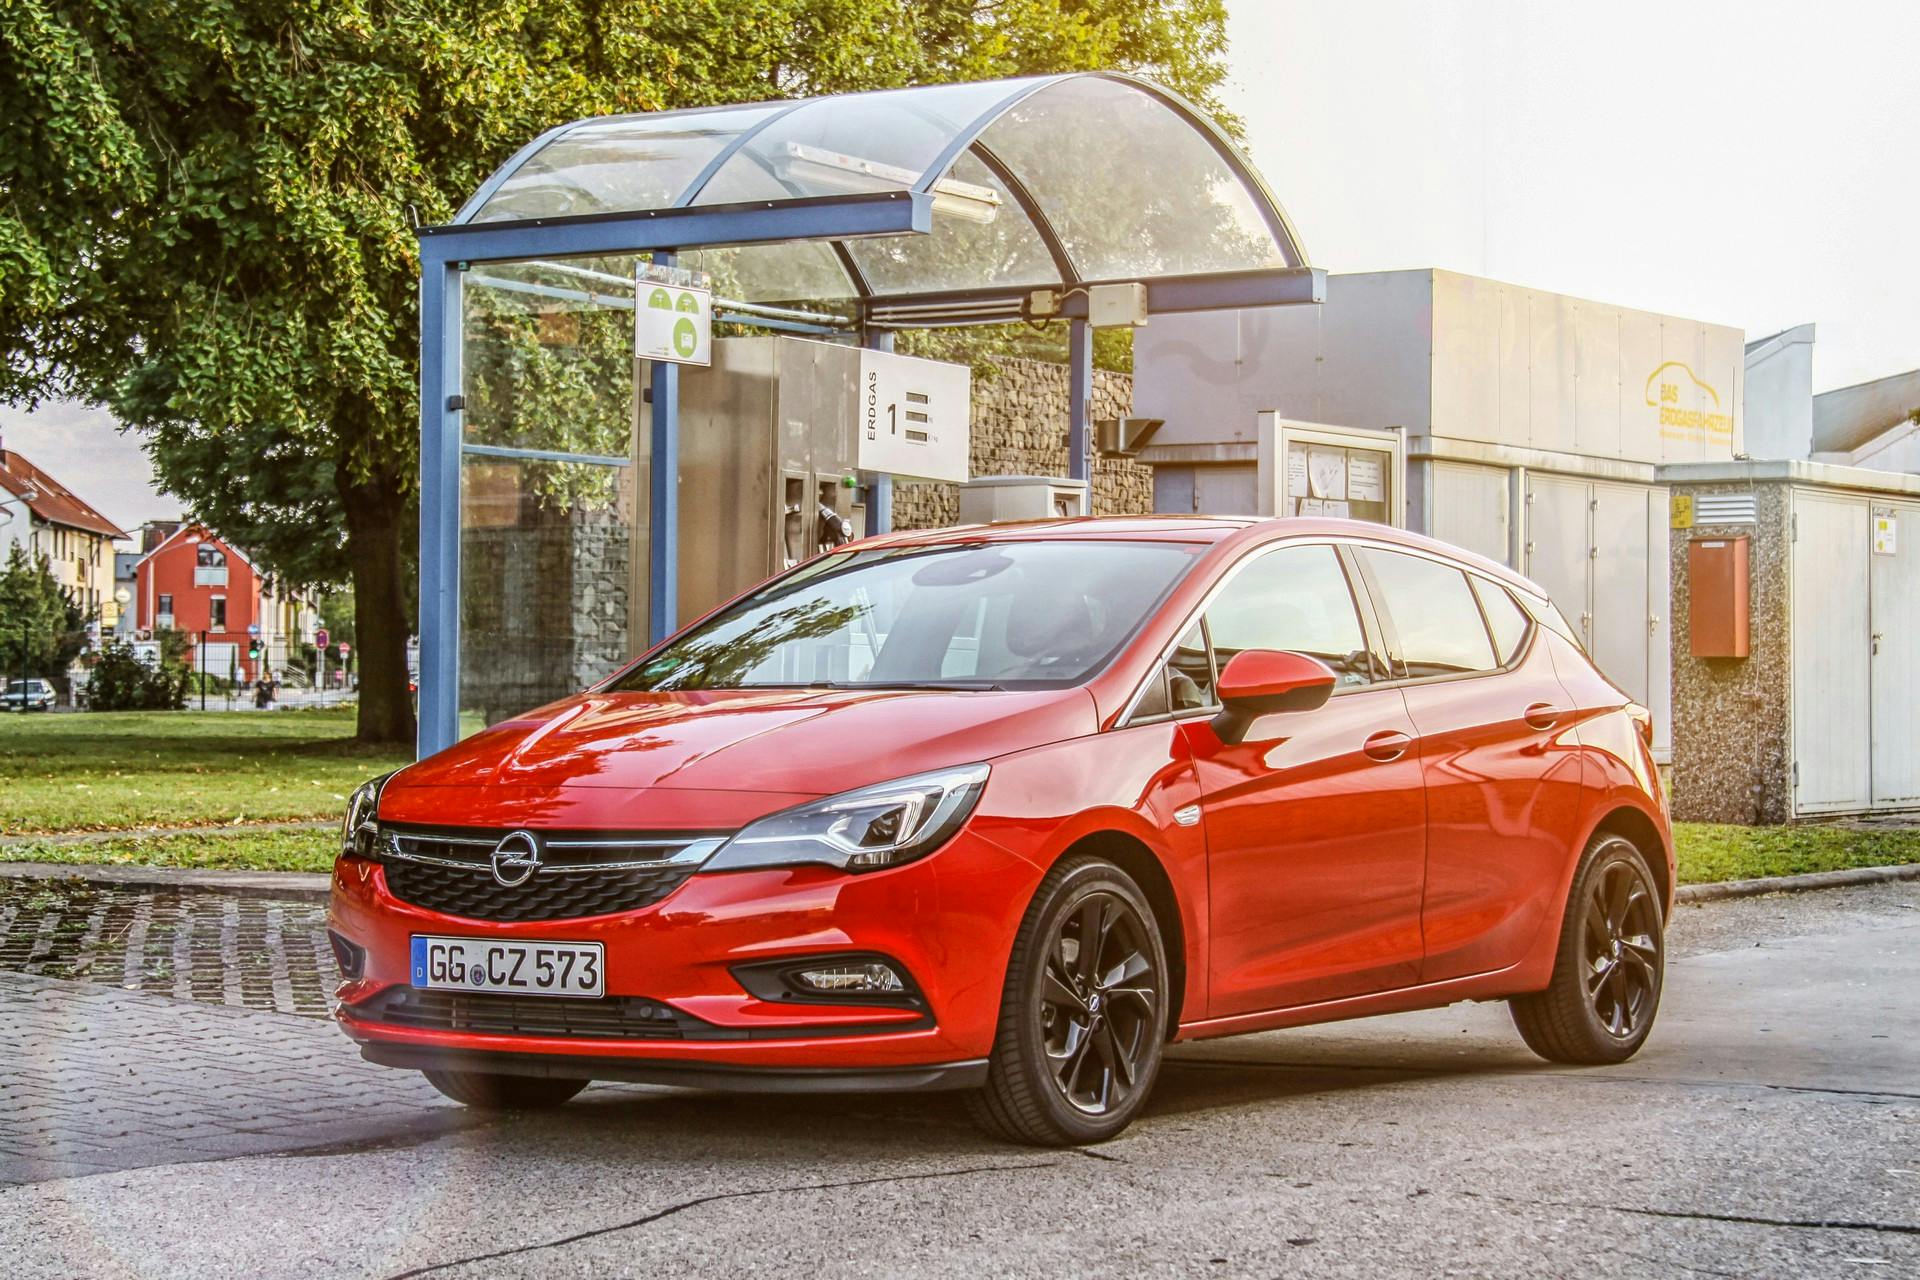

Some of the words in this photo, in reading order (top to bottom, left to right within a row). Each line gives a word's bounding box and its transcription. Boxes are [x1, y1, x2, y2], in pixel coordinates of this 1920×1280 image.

[867, 371, 877, 441] ERDGAS
[887, 403, 896, 435] 1
[416, 967, 423, 978] D
[429, 944, 466, 983] GG
[487, 947, 528, 987] CZ
[535, 949, 598, 989] 573
